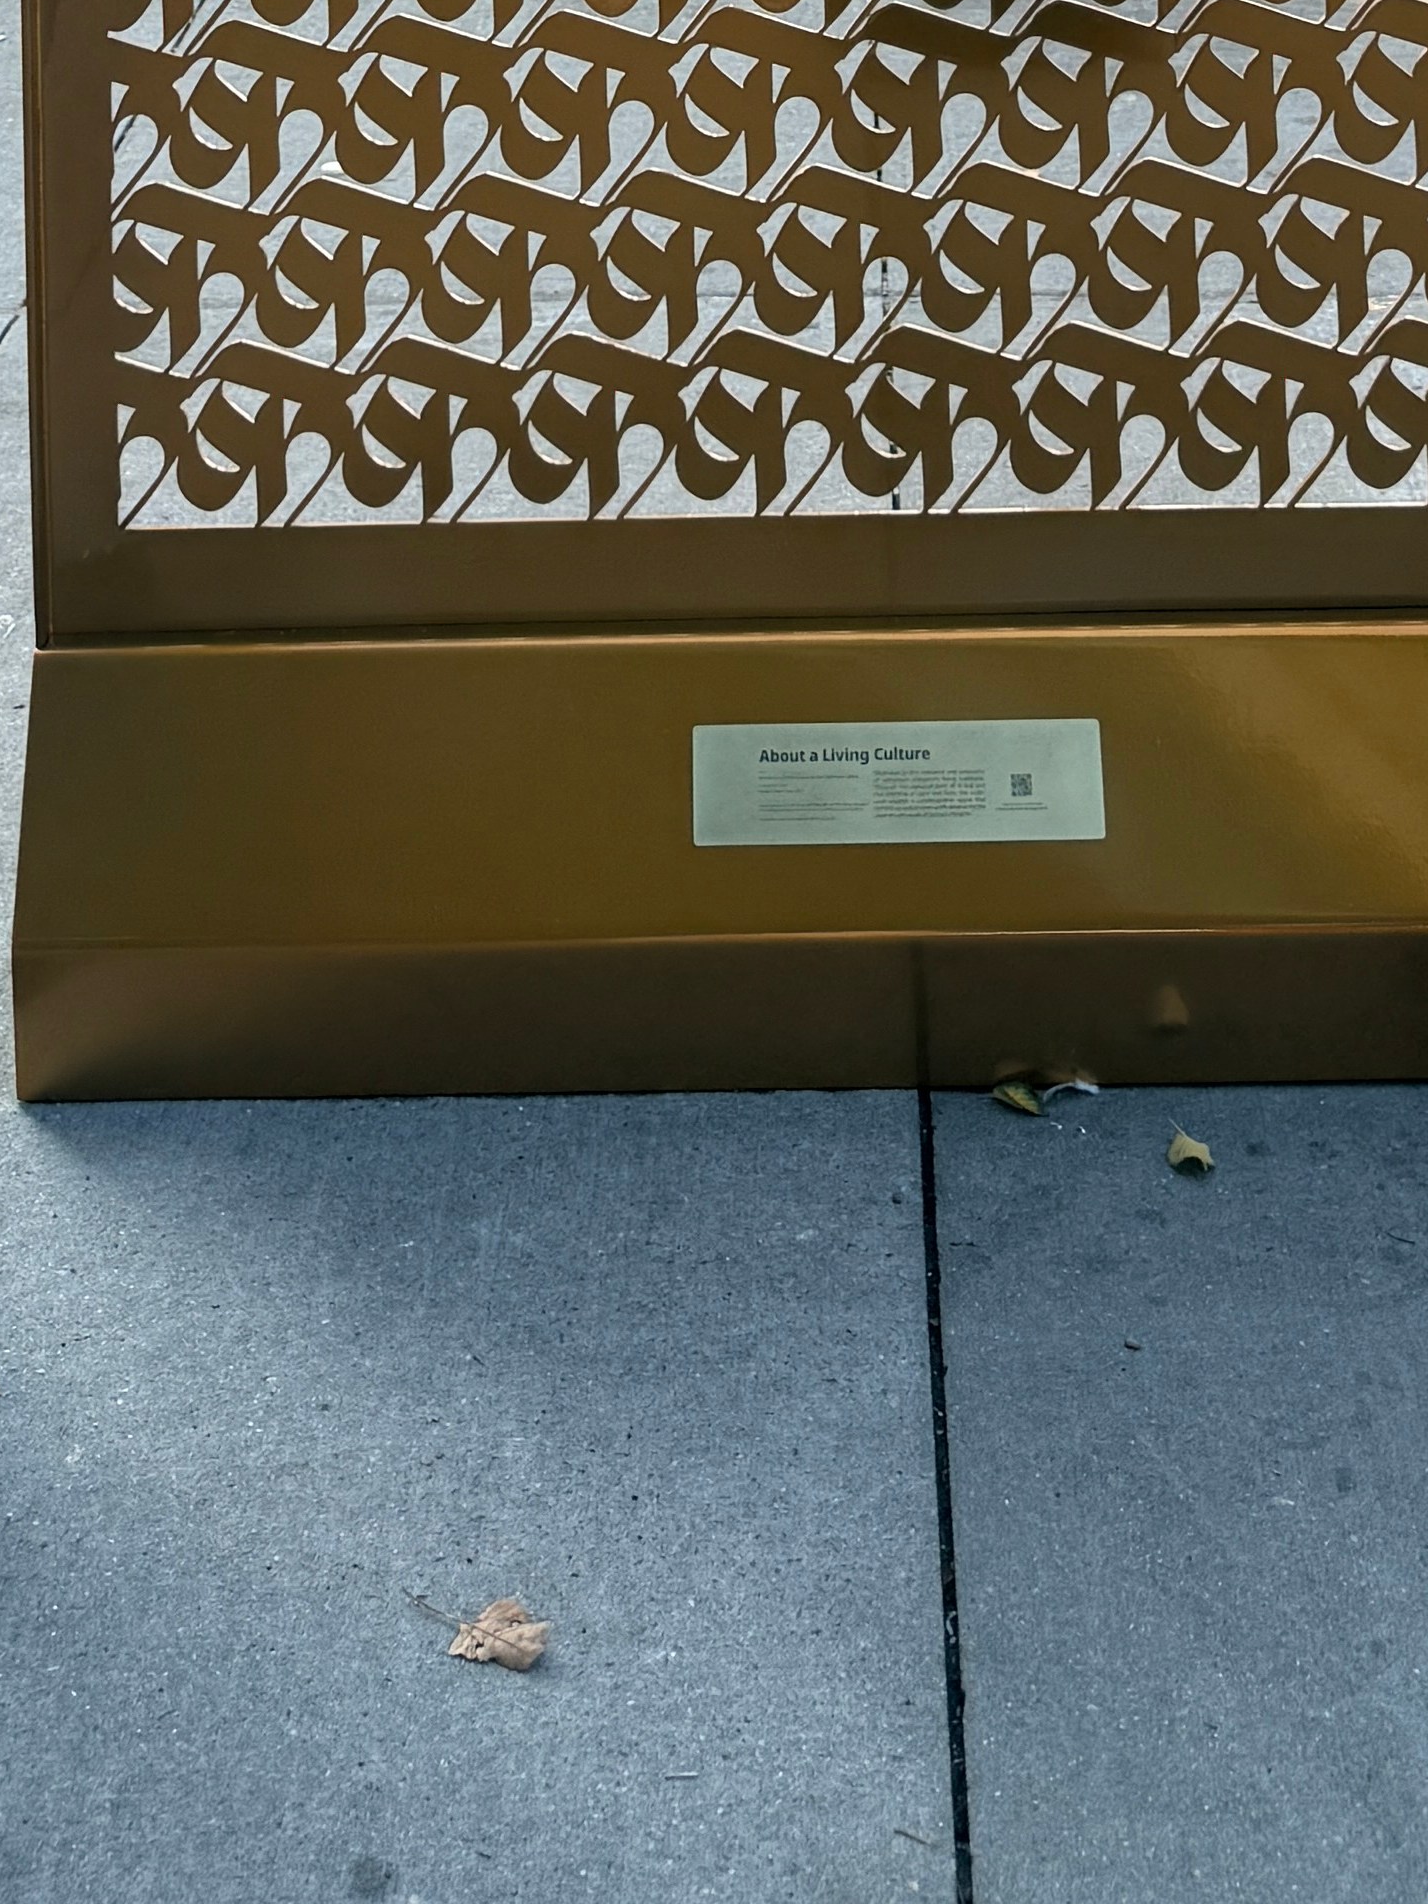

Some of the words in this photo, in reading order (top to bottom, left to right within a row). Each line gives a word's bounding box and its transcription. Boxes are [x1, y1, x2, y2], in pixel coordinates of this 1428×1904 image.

[759, 749, 806, 763] About
[809, 751, 819, 763] a
[823, 748, 870, 765] Living
[874, 747, 931, 761] Culture
